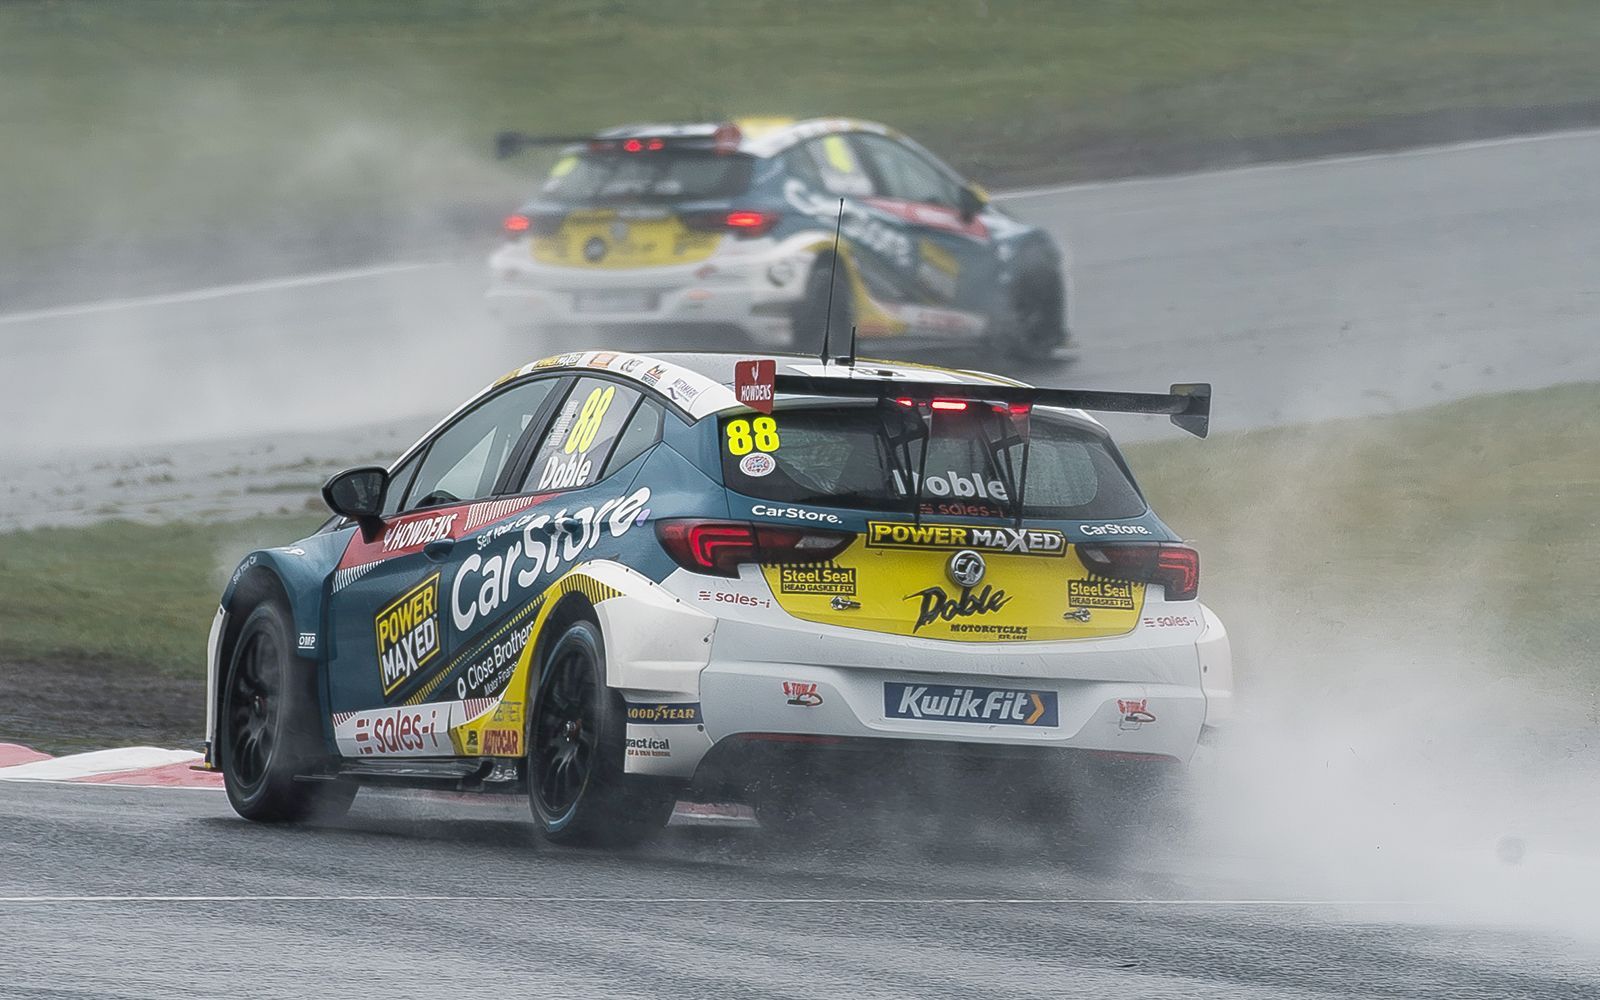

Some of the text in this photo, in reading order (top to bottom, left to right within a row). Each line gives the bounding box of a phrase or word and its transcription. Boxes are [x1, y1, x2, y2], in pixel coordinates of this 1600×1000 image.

[741, 384, 772, 401] HOWDENS
[564, 386, 616, 455] 88
[726, 416, 780, 456] 88
[538, 453, 592, 490] Doble
[751, 505, 843, 524] CarStore.
[389, 512, 459, 552] HOWDENS
[875, 525, 1061, 552] POWER MAXED
[783, 570, 854, 583] Steel Seal
[784, 583, 854, 593] HEAD GASKET FIX
[715, 592, 771, 608] sales-i
[1070, 581, 1130, 598] Steel Seal
[902, 584, 1015, 634] Doble
[299, 636, 316, 646] OMP
[379, 586, 436, 686] POWER MAXED
[950, 624, 1028, 635] MOTORCYCLES
[467, 656, 495, 690] Close
[498, 661, 517, 684] Financ
[374, 710, 438, 754] sales-i
[626, 738, 670, 750] ractical
